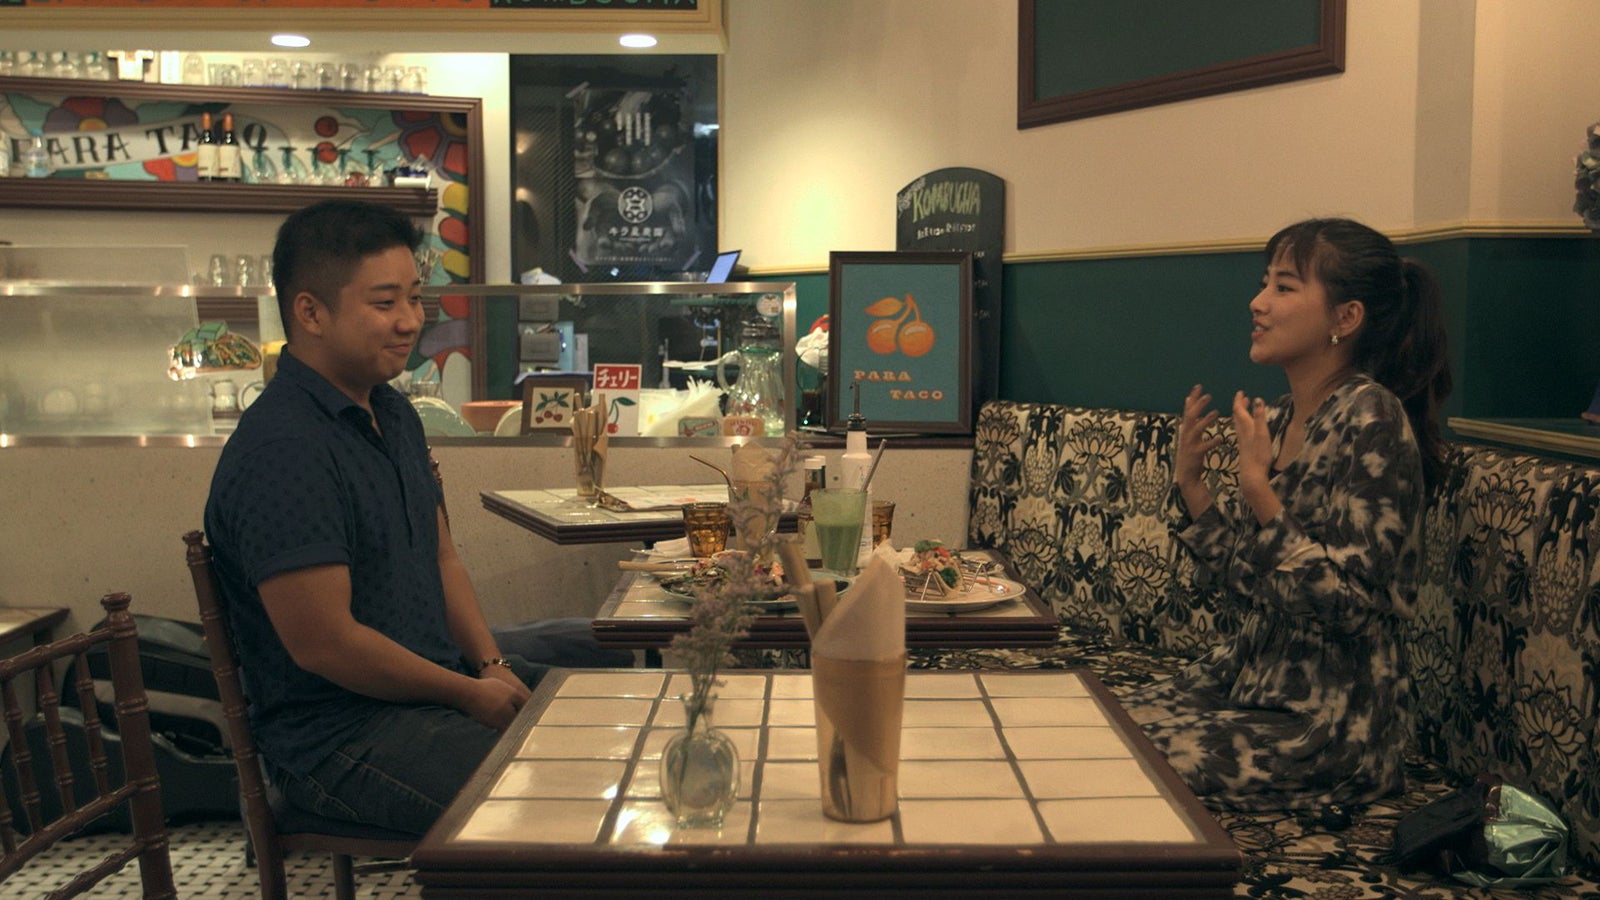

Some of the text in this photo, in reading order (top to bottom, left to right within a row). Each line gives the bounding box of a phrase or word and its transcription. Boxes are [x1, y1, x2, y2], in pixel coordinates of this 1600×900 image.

[147, 123, 267, 155] TAO
[912, 181, 981, 222] KOMBUCHA
[597, 368, 638, 387] チェリー
[853, 370, 912, 382] PARA
[889, 389, 944, 400] TACO
